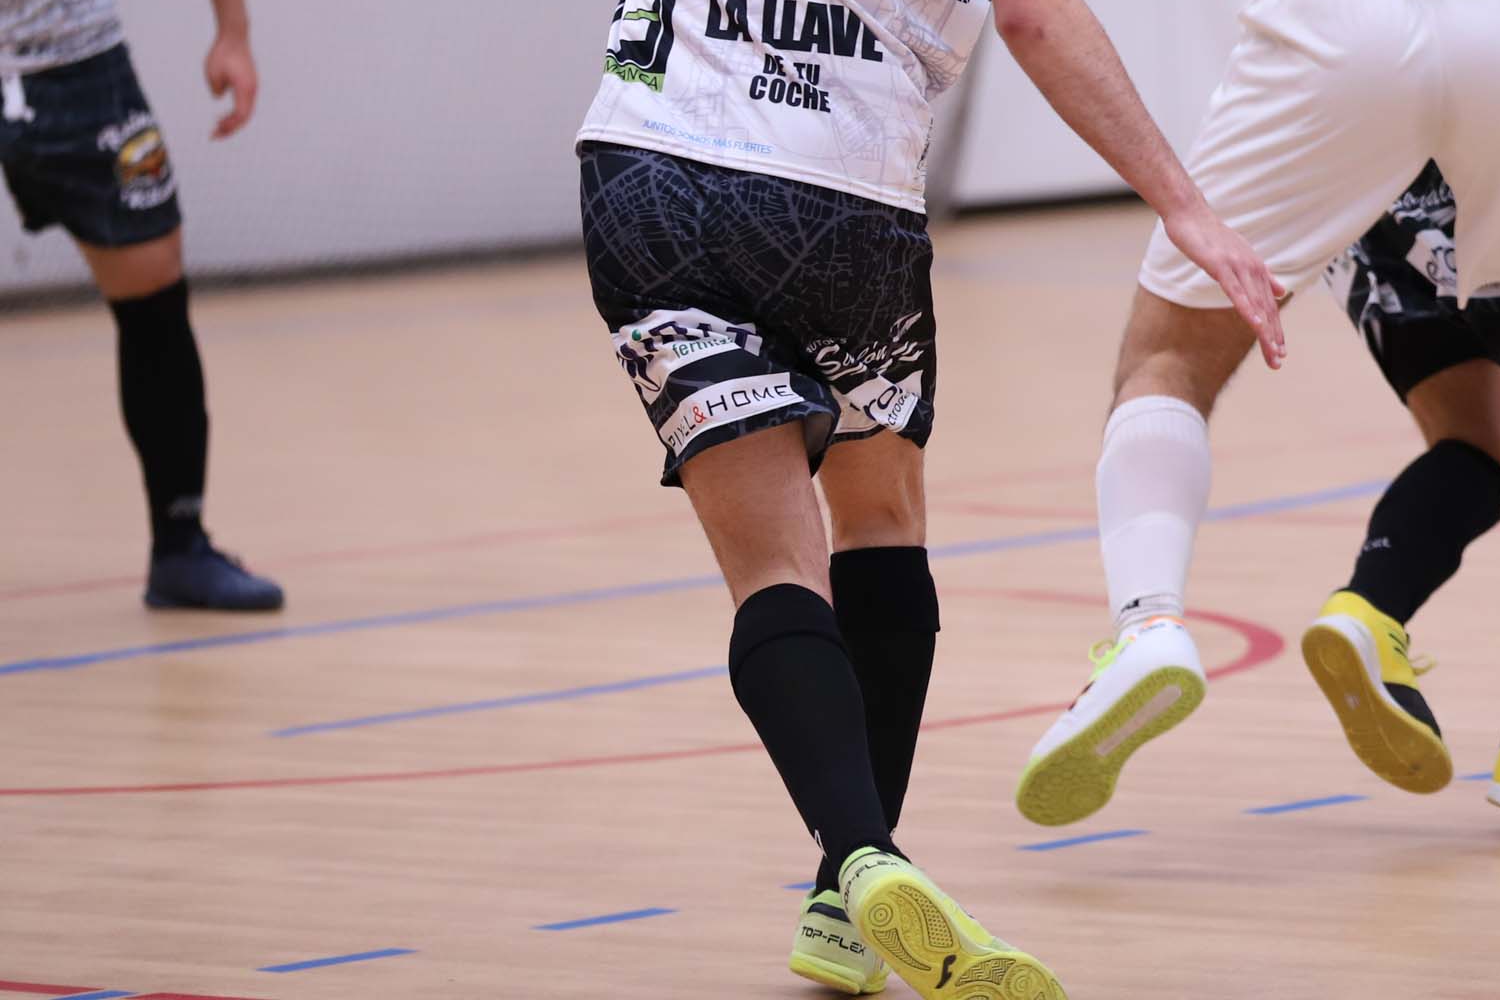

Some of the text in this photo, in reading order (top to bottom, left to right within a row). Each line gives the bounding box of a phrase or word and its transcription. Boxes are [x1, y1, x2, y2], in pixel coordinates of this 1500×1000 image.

[763, 53, 820, 86] DE TU
[749, 75, 831, 113] COCHE
[802, 926, 867, 957] TOP-FLEX
